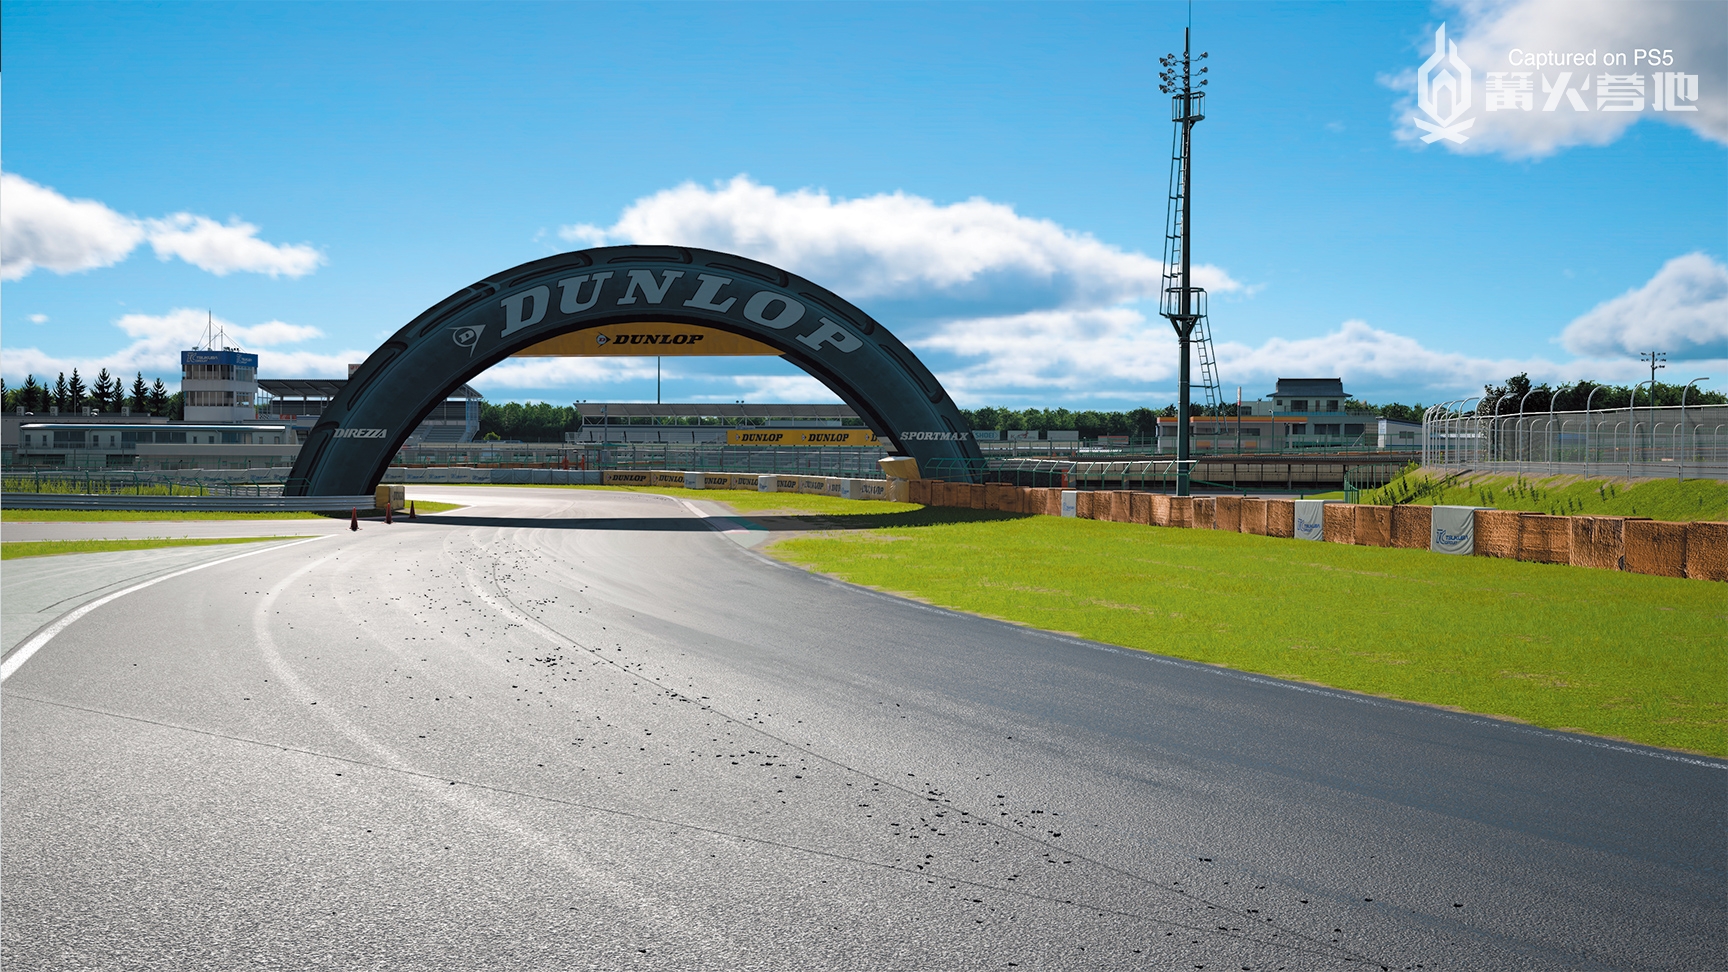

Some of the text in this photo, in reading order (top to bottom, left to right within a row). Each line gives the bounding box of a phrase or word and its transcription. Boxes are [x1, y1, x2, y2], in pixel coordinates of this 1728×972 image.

[500, 269, 864, 353] DUNLOP
[612, 334, 704, 344] DUNLOP
[332, 428, 388, 439] DIREZZA
[741, 433, 849, 442] DUNLOP DUNLOP
[900, 432, 969, 441] SPORTMAX
[612, 474, 647, 482] DUNLOP
[659, 474, 684, 483] DUNLO
[738, 477, 758, 486] DUNLO
